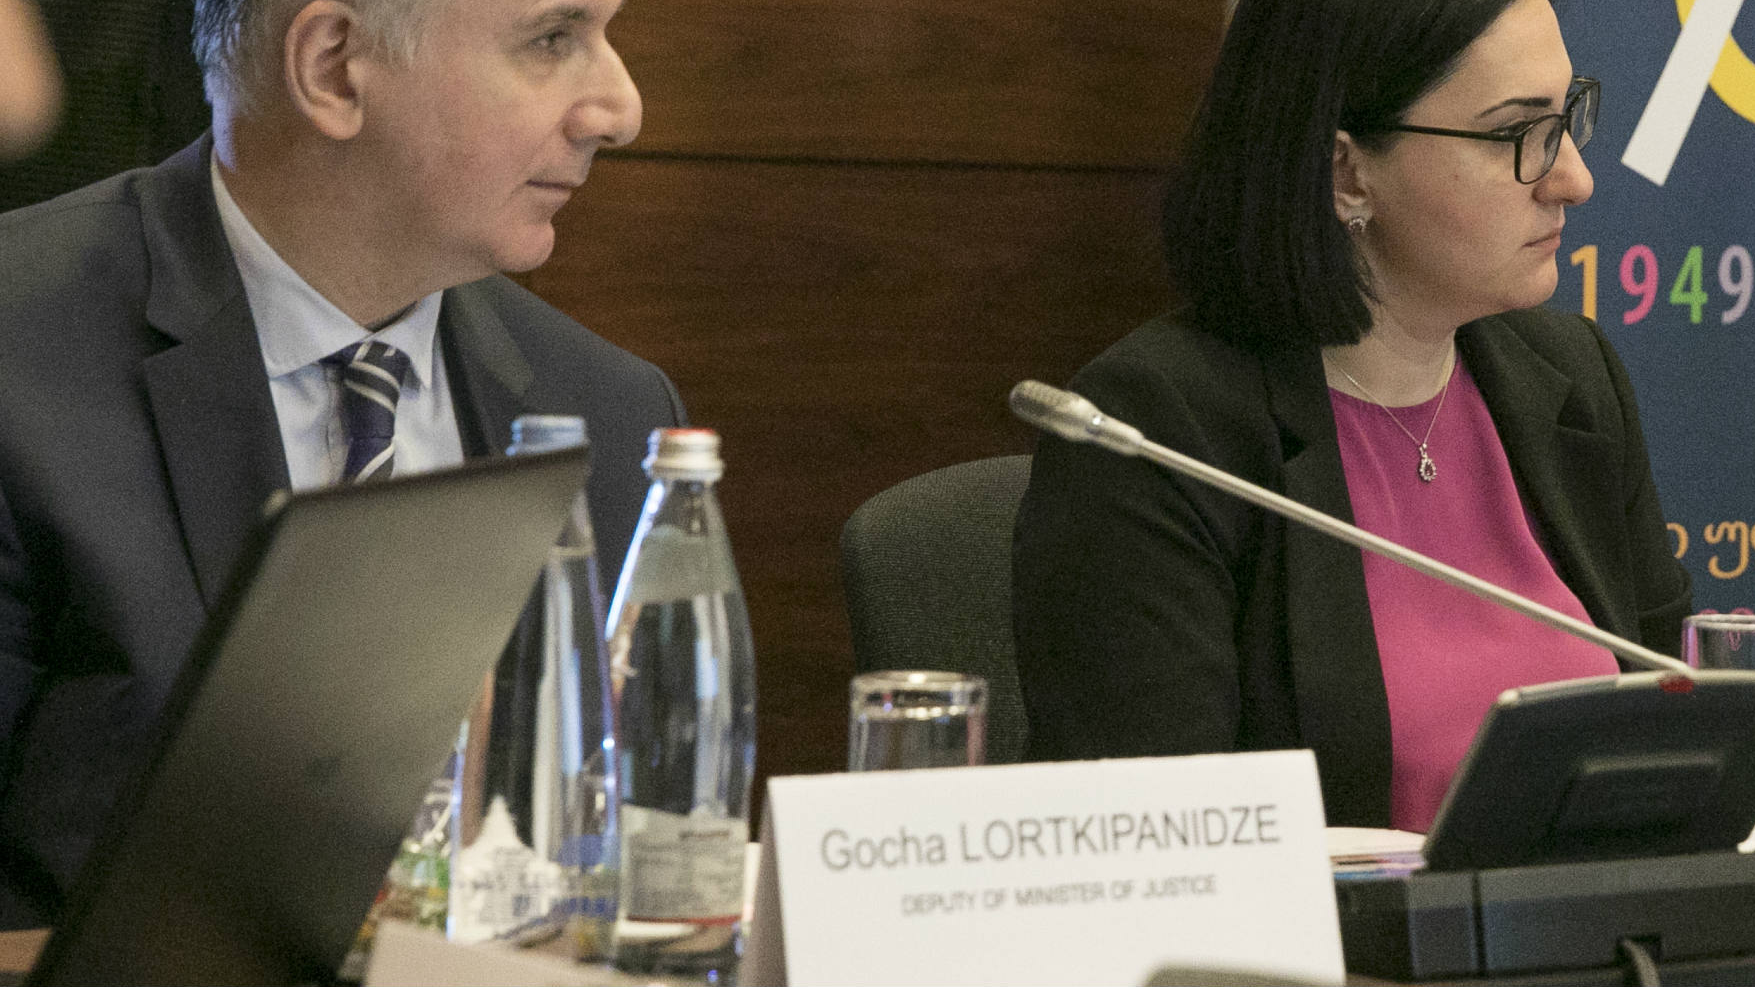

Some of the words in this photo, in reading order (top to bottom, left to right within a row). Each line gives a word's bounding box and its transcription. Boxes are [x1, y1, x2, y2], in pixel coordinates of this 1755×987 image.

[820, 828, 947, 871] Gocha
[961, 805, 1280, 863] LORTKIPANIDZE
[902, 892, 976, 916] DEPUTY
[984, 887, 1006, 909] OF
[1016, 881, 1105, 907] MINISTER
[1111, 878, 1136, 901] OF
[1143, 874, 1217, 899] JUSTICE
